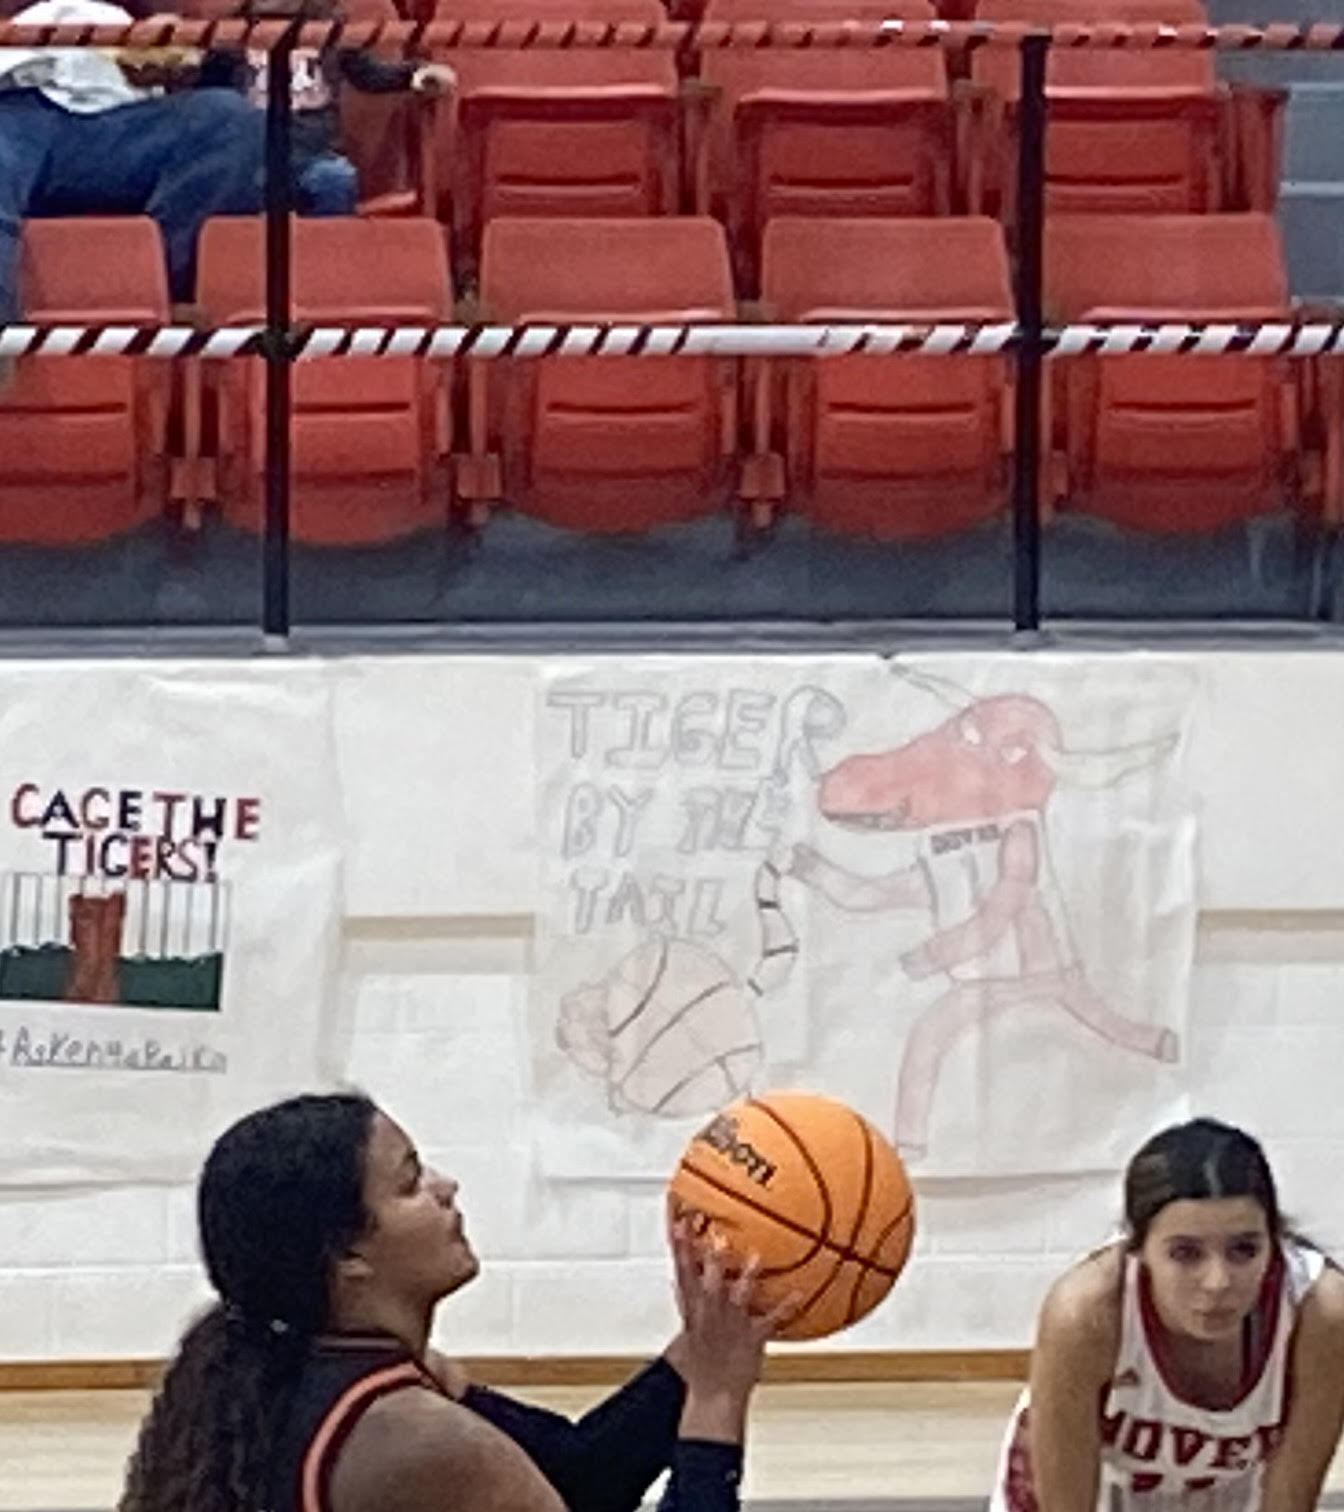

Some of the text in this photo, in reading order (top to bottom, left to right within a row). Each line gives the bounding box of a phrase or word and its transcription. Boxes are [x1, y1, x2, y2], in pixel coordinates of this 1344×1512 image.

[545, 684, 848, 781] TIGER
[11, 783, 262, 841] CAGE THE
[561, 776, 790, 860] BY THE
[42, 830, 219, 884] TIGERS!
[568, 865, 728, 936] TAIL
